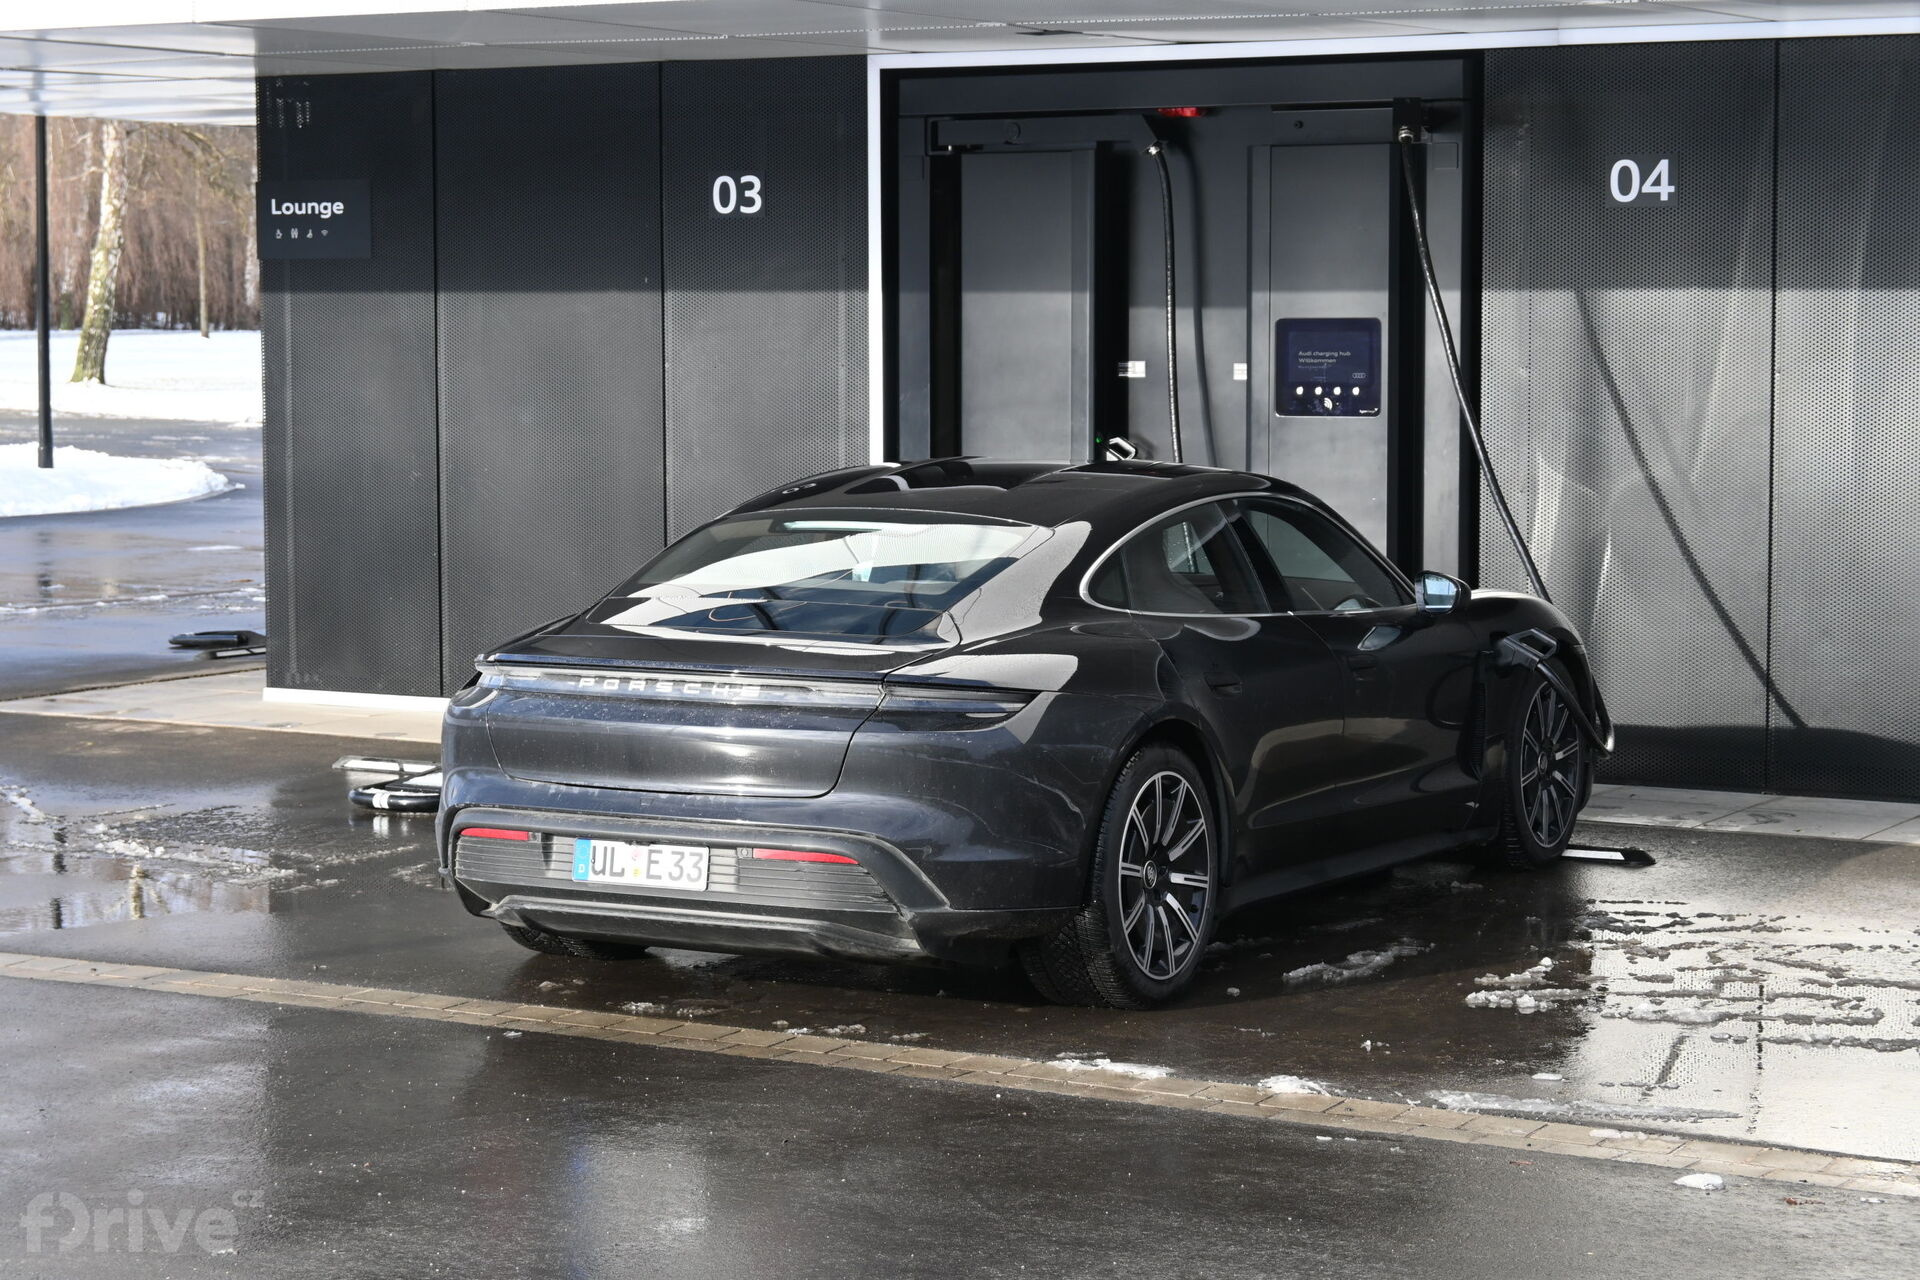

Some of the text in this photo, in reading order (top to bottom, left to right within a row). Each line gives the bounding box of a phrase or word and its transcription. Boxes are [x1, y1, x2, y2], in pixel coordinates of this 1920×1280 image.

[713, 175, 762, 214] 03
[1610, 159, 1675, 202] 04
[271, 199, 344, 218] Lounge
[578, 677, 761, 698] PORSCHE
[591, 845, 704, 883] UL E 33
